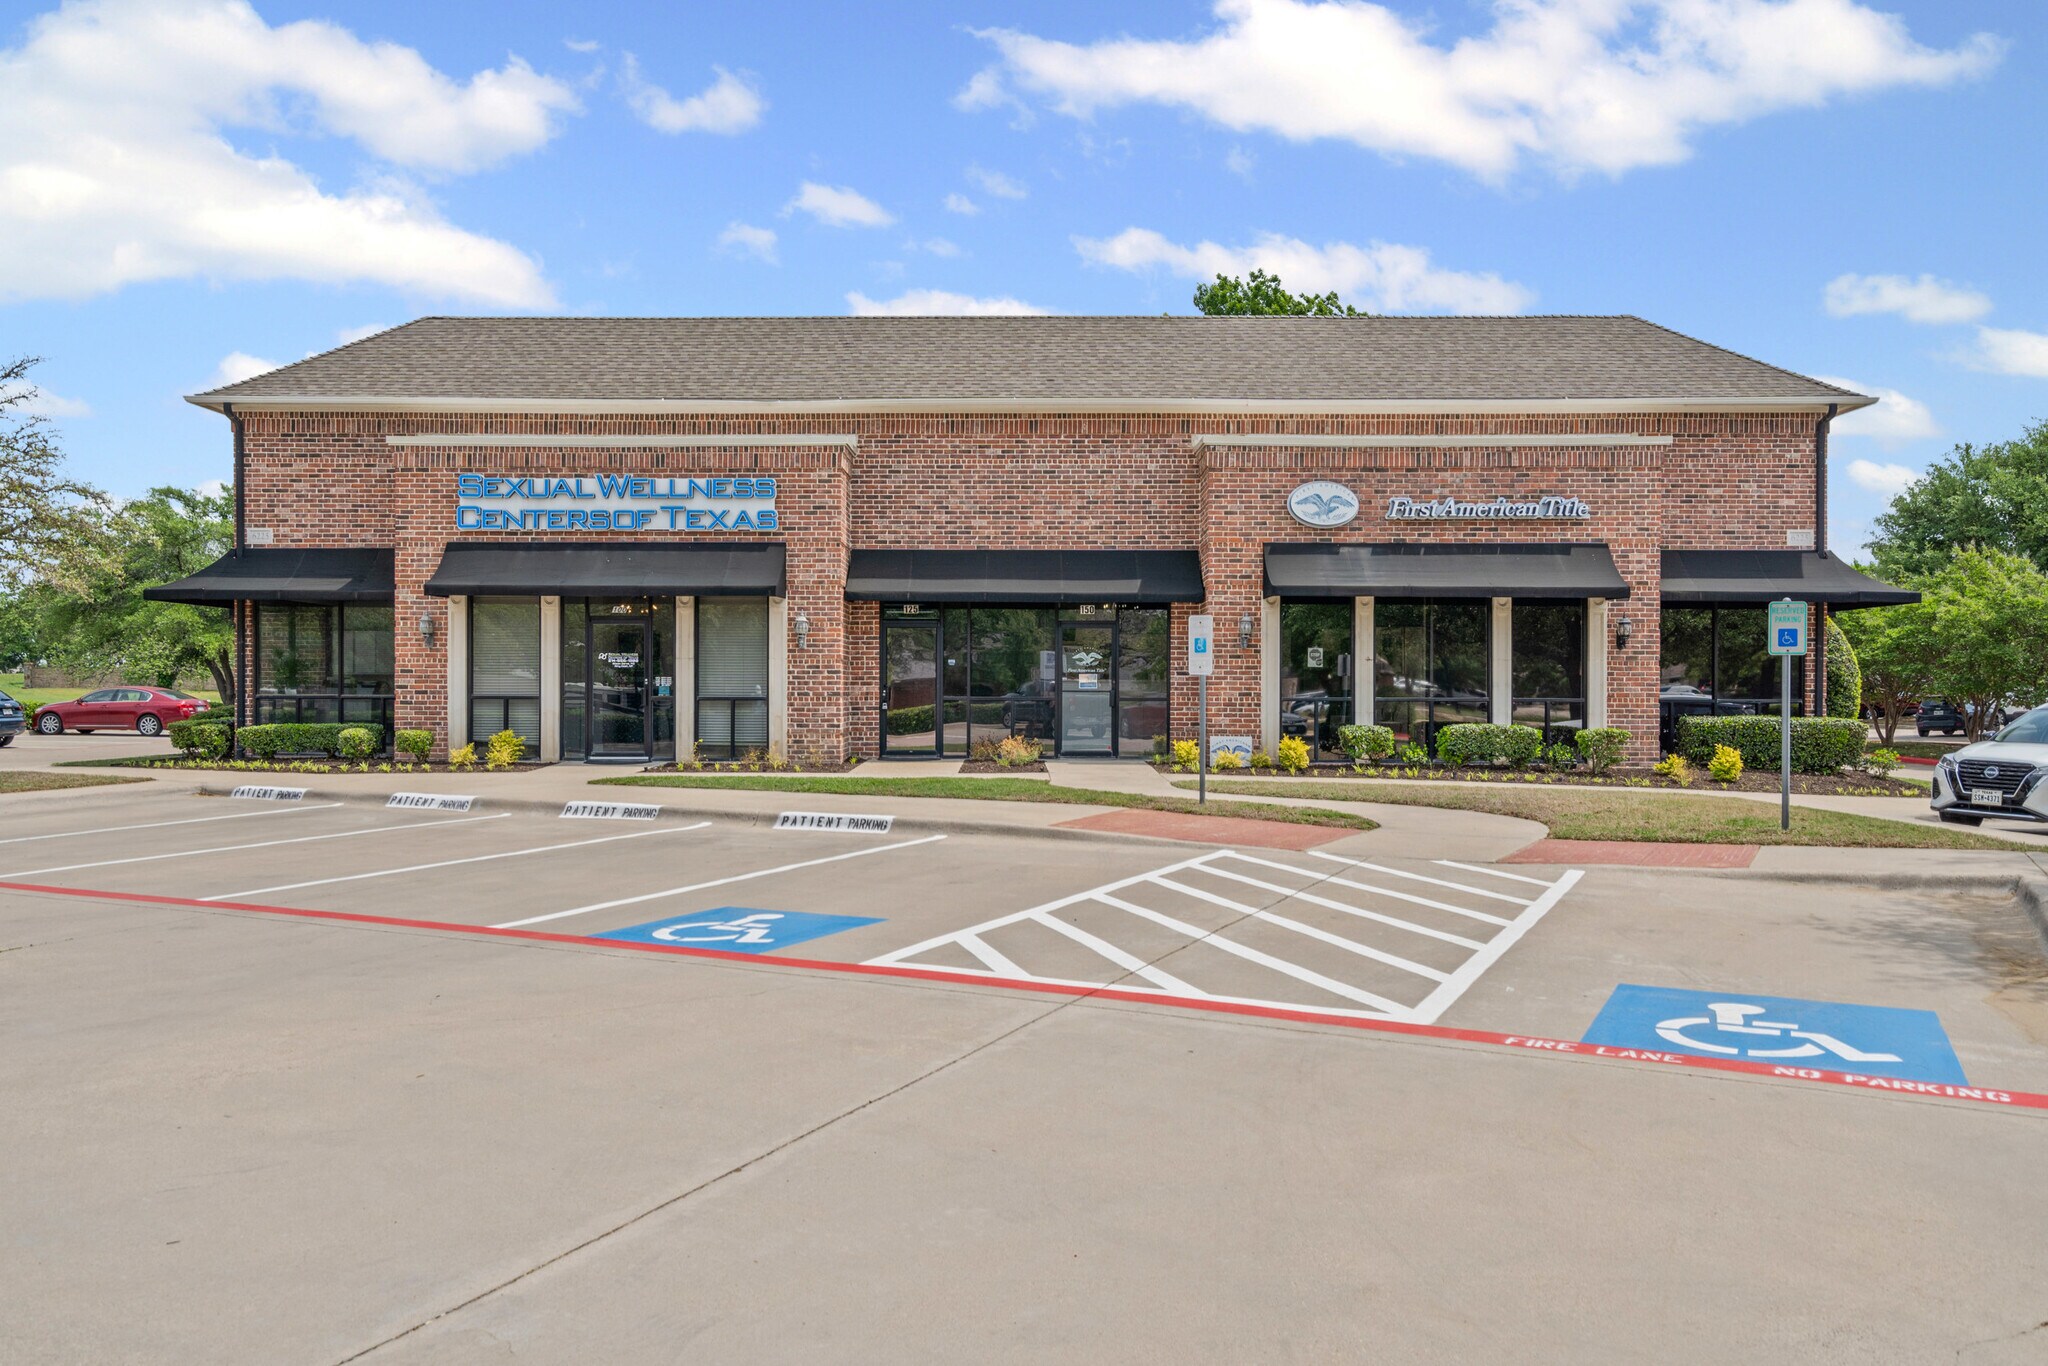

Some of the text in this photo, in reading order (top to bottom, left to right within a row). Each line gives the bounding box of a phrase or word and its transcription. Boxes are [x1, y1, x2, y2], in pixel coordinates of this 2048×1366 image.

[457, 474, 776, 499] SEXUAL WELLNESS
[1386, 496, 1590, 519] First American Title
[660, 505, 778, 530] TEXAS
[903, 605, 919, 614] 125
[1080, 605, 1096, 614] 150
[234, 788, 303, 800] PATIENT PARKING
[389, 795, 469, 810] PATIENT PARKING
[564, 805, 657, 819] PATIENT PARKING
[781, 815, 888, 831] PATIENT PARKING
[1504, 1037, 2012, 1103] FIRE LANE NO PARKING
